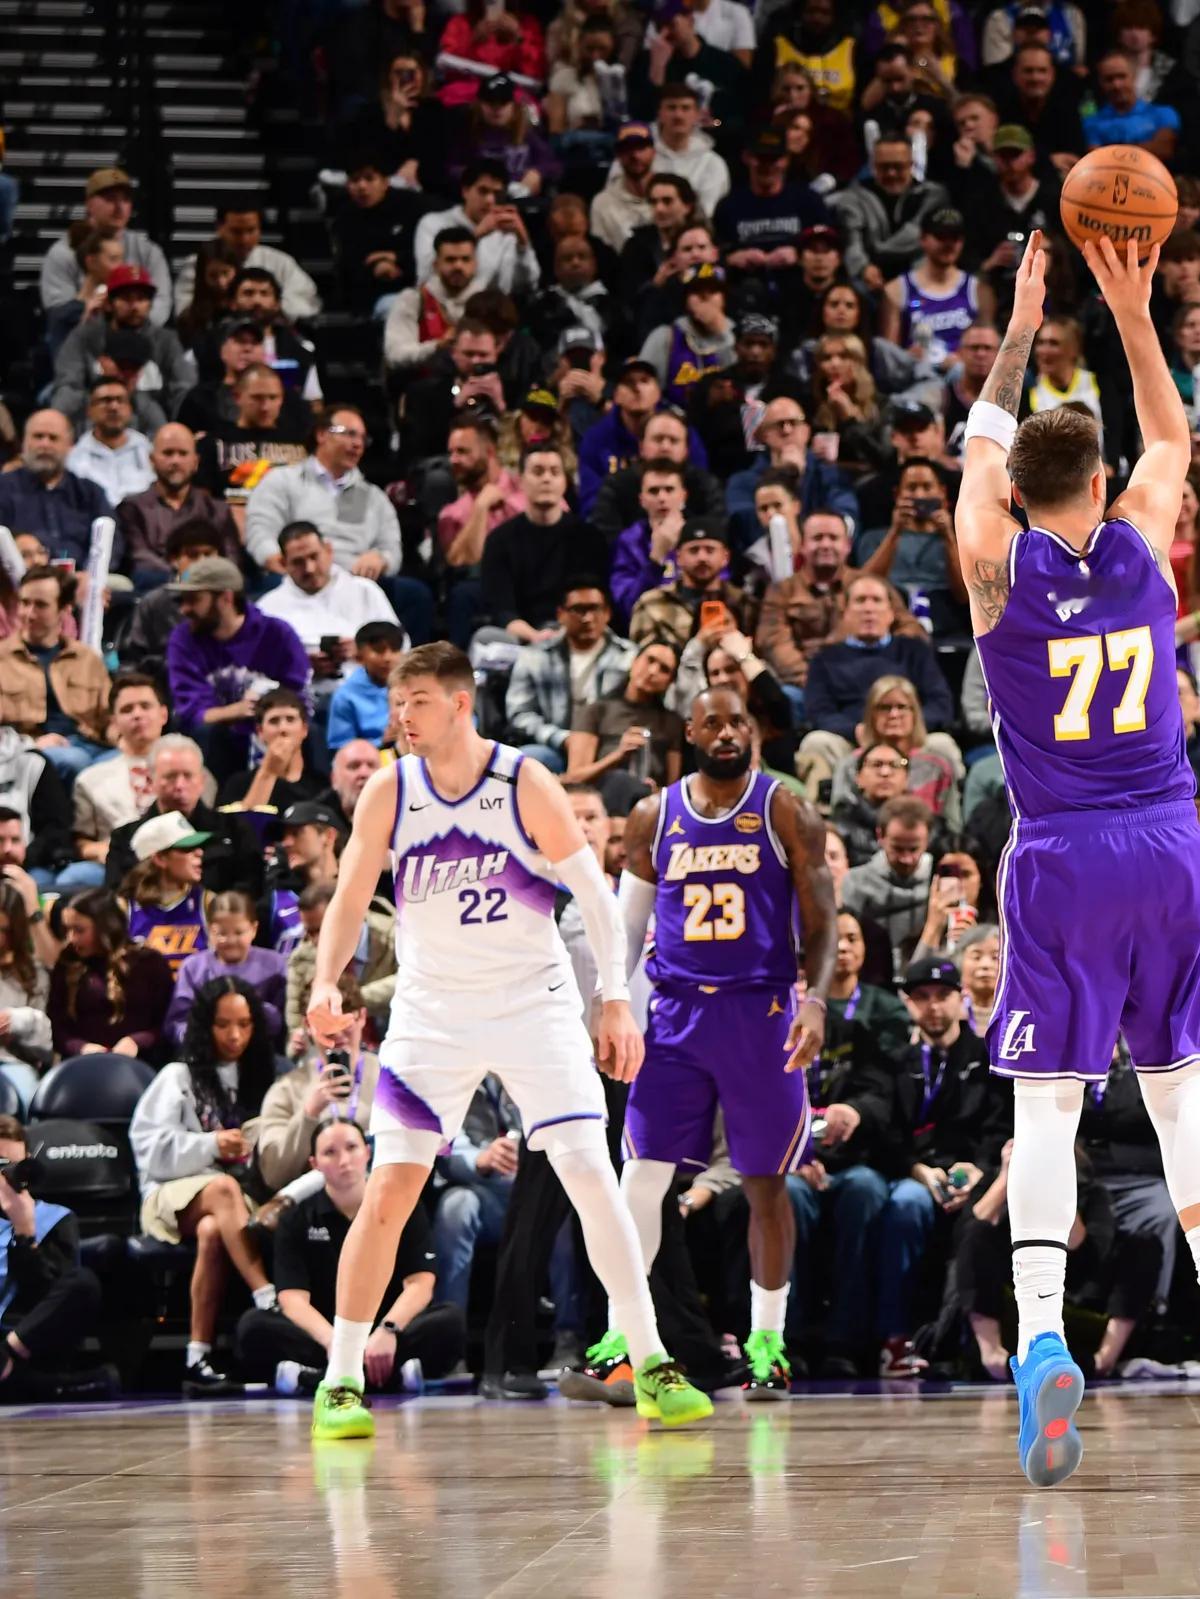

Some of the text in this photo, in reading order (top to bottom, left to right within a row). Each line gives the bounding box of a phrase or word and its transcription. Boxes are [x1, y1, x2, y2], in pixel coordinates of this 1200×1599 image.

[1047, 625, 1154, 742] 77
[479, 797, 505, 811] LVT
[402, 850, 511, 904] UTAH
[664, 842, 761, 882] LAKERS
[458, 887, 509, 926] 22
[683, 883, 746, 942] 23
[999, 1010, 1037, 1061] LA
[46, 1143, 119, 1160] entrata
